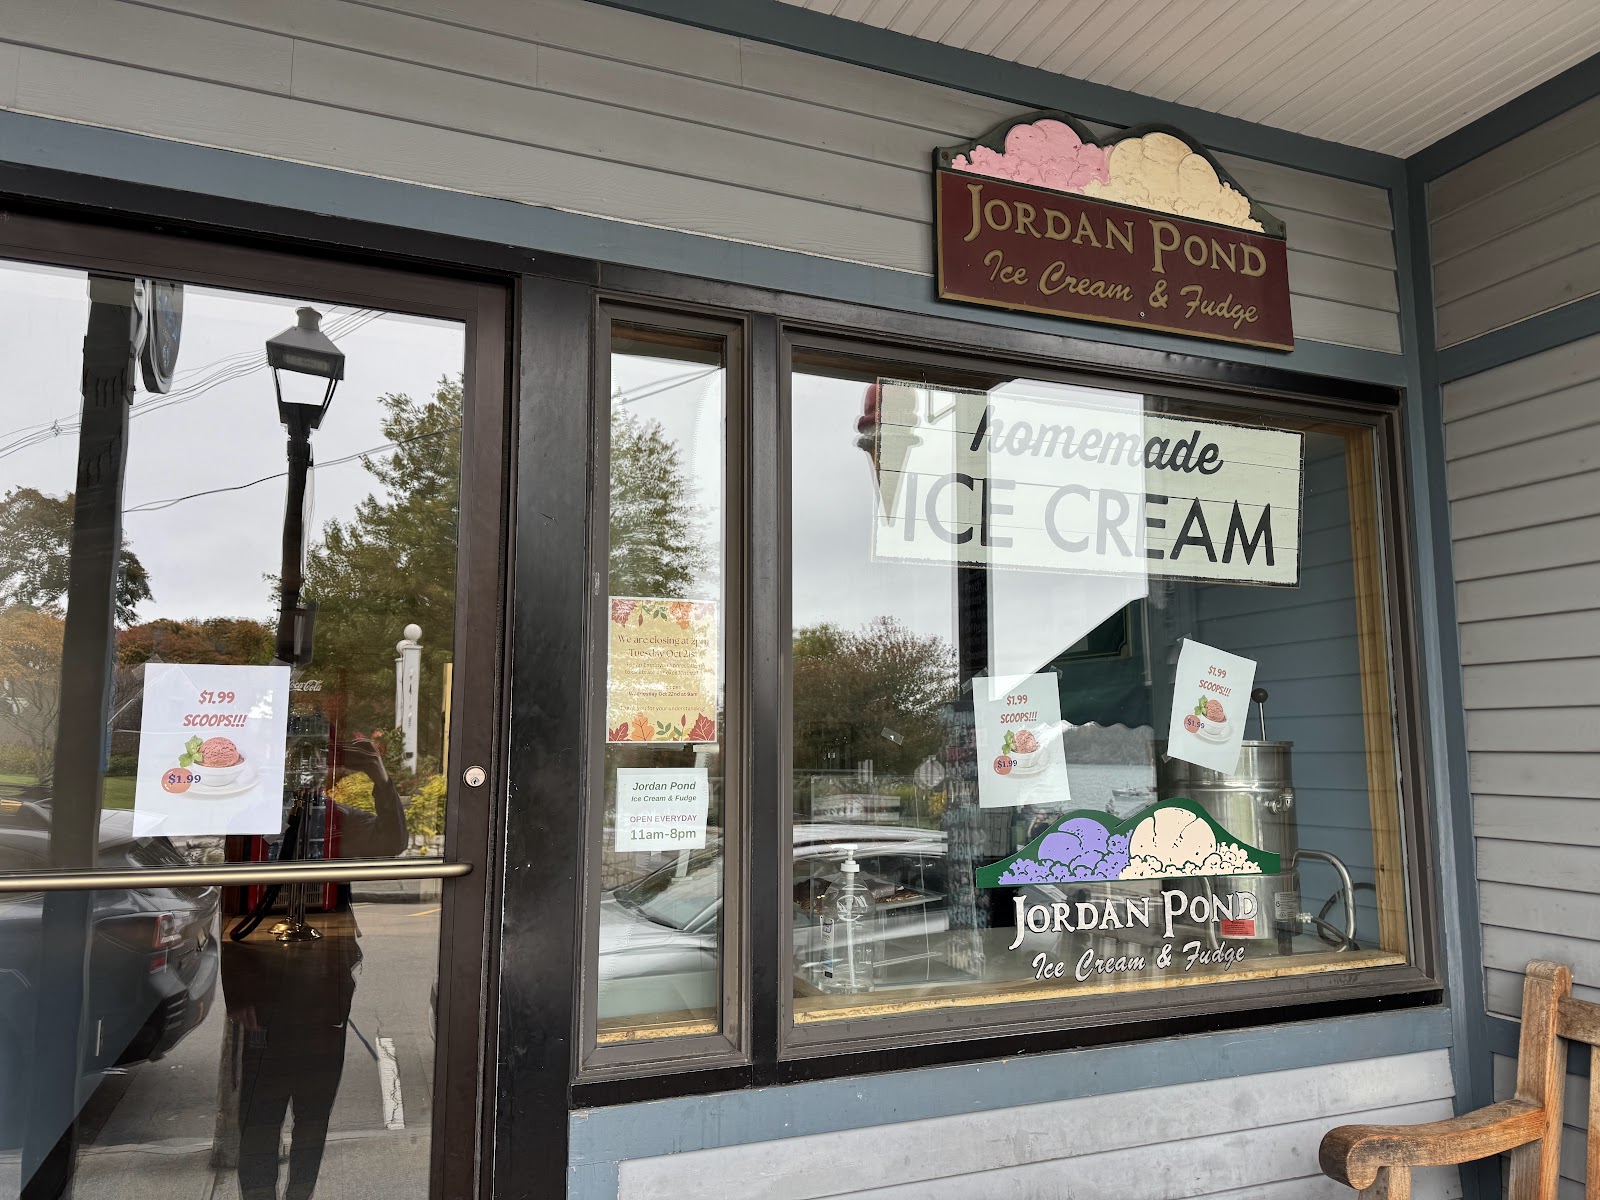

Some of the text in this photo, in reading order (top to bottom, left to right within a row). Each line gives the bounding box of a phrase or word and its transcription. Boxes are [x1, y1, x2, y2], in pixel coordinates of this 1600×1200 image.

[963, 183, 1267, 278] JORDAN POND
[983, 249, 1259, 329] Ice Cream & Fudge
[970, 404, 1225, 476] homemade
[903, 472, 1276, 567] ICE CREAM
[618, 634, 632, 643] We
[649, 635, 680, 646] closing
[666, 650, 681, 658] Oct
[1208, 665, 1227, 679] $1.99
[1198, 679, 1232, 697] SCOOPS!!!
[198, 690, 236, 705] $1.99
[1006, 694, 1028, 706] $1.99
[183, 713, 248, 728] SCOOPS!!!
[1000, 711, 1038, 724] SCOOPS!!!
[1187, 718, 1205, 729] $1.99
[997, 759, 1018, 769] $1.99
[168, 773, 202, 786] $1.99
[632, 781, 697, 791] Jordan Pond
[675, 795, 697, 803] Fudge
[629, 814, 698, 823] OPEN EVERYDAY
[630, 828, 697, 841] 11am-8pm
[1008, 895, 1150, 951] JORDAN
[1160, 889, 1259, 939] POND
[1031, 940, 1246, 983] Ice Cream & Fudge
